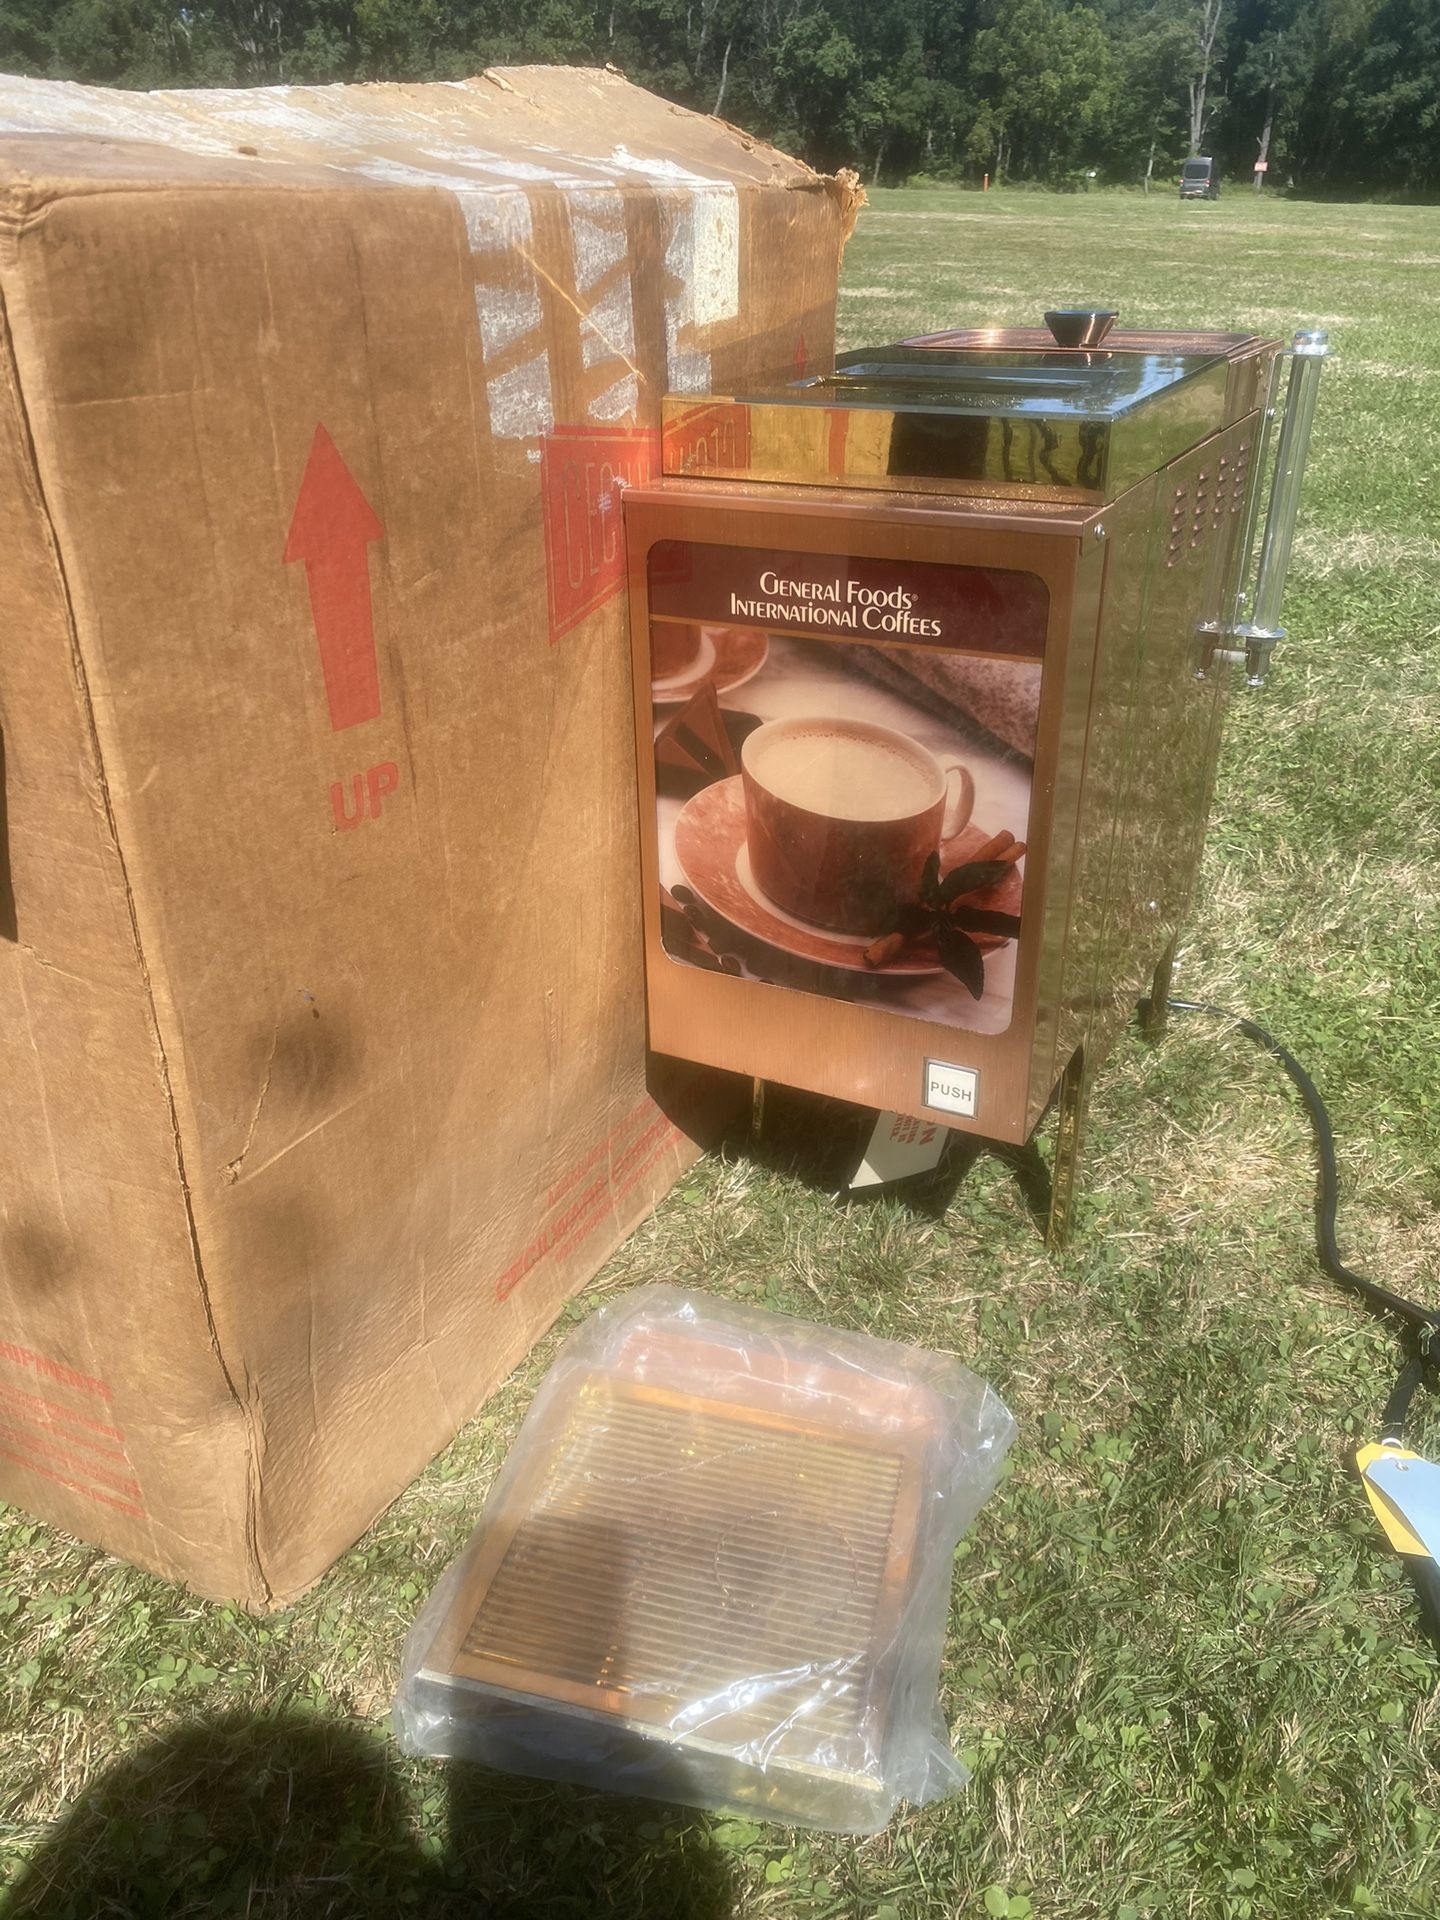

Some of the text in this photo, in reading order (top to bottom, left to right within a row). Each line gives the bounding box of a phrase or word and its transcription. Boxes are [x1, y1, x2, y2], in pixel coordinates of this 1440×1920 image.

[759, 571, 841, 603] GENERAL
[330, 762, 399, 832] UP
[930, 1081, 972, 1102] PUSH
